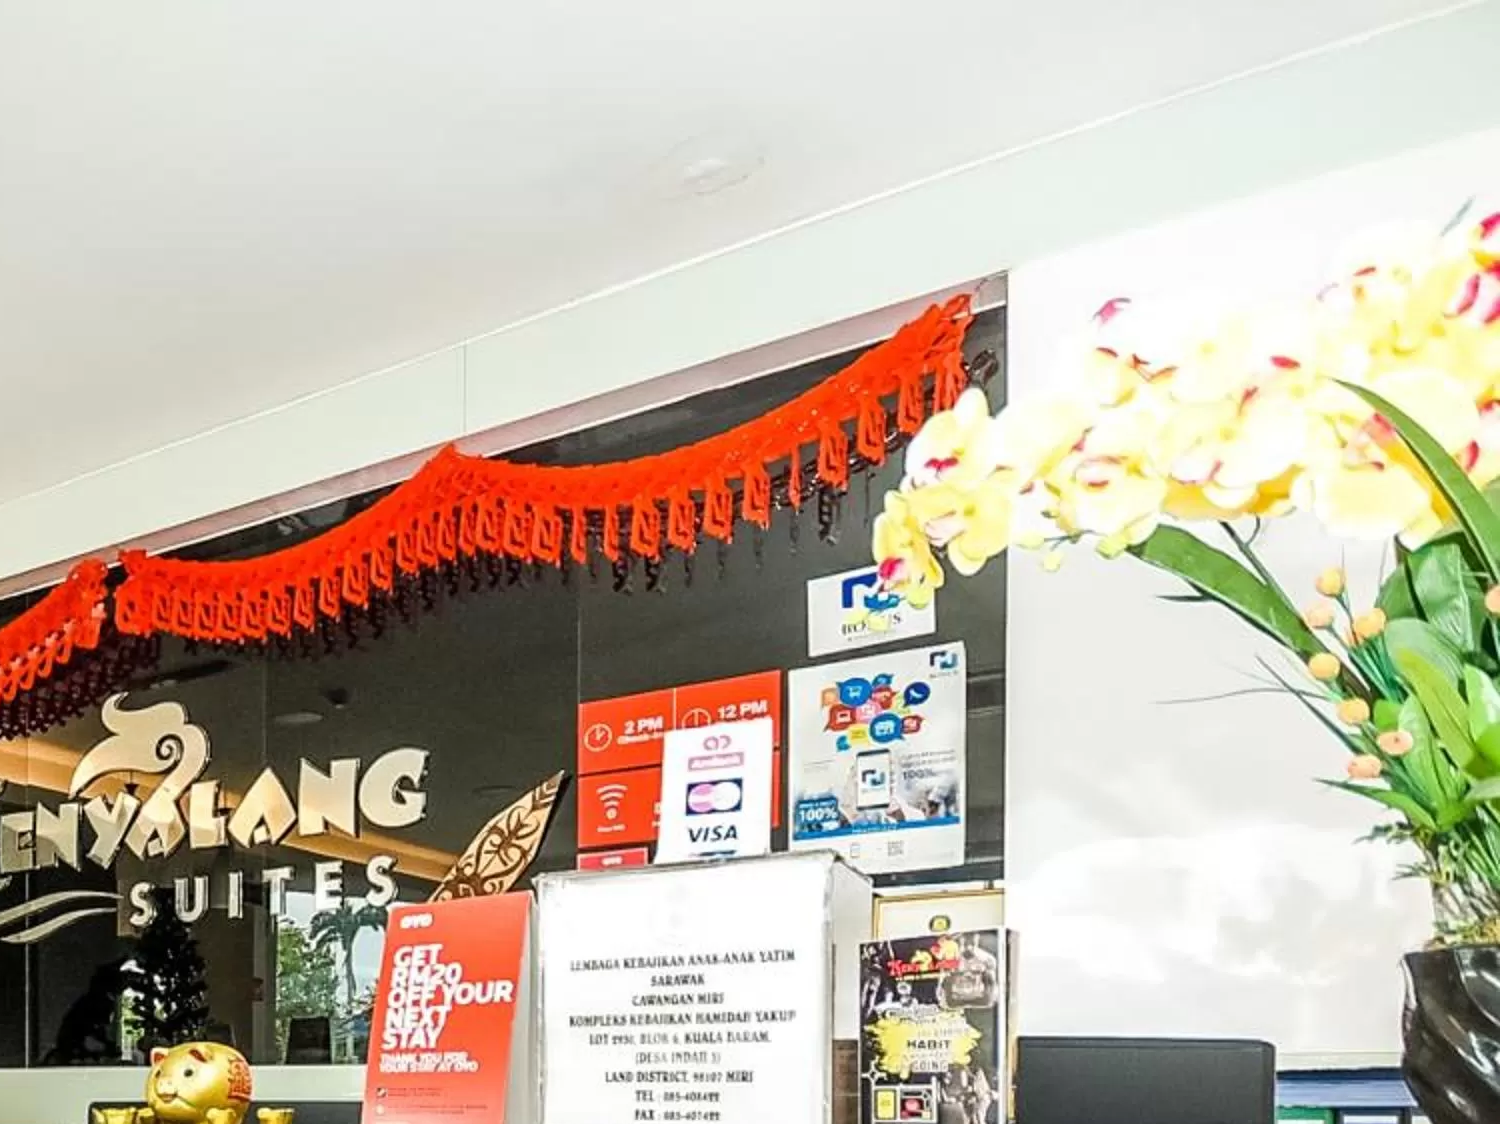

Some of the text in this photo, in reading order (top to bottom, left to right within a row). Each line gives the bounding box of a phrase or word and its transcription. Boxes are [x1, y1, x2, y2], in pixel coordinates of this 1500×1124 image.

[718, 699, 768, 719] 12 PM
[623, 715, 665, 734] 2 PM
[798, 806, 838, 822] 100%
[687, 824, 739, 843] VISA
[129, 855, 399, 927] SUITES
[400, 913, 433, 929] OYO
[393, 943, 444, 967] GET
[687, 951, 755, 966] ANAK-ANAK
[759, 949, 796, 963] YATIM
[390, 962, 463, 987] RM20
[650, 973, 705, 987] SARAWAK
[387, 979, 514, 1008] OFF YOUR
[631, 993, 694, 1007] CAWANGAN
[385, 1004, 452, 1029] NEXT
[569, 1014, 627, 1028] KOMPLEKS
[381, 1027, 443, 1050] STAY
[589, 1033, 608, 1045] LOT
[684, 1030, 723, 1044] KUALA
[906, 1039, 952, 1050] HABIT
[605, 1071, 634, 1083] LAND
[725, 1070, 754, 1083] MIRI
[635, 1089, 655, 1102] TEL
[634, 1108, 655, 1121] FAX
